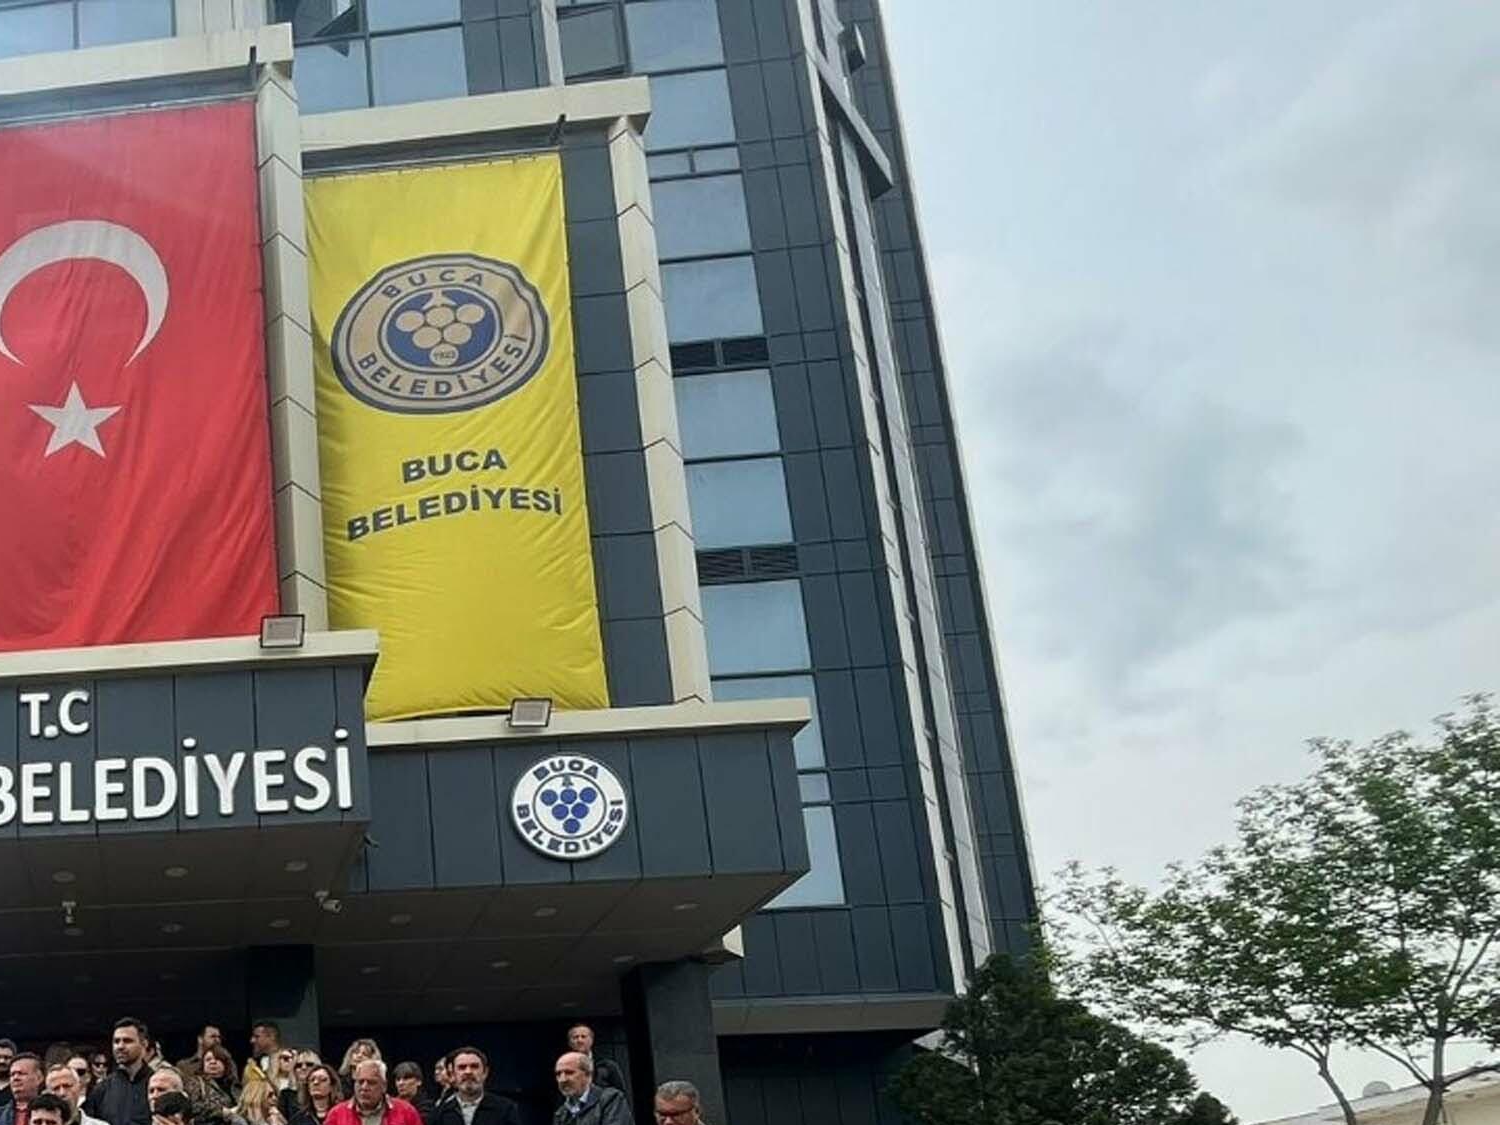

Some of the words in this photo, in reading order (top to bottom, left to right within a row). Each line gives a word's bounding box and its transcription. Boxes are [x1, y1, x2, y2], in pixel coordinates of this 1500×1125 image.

[382, 270, 484, 299] BUCA
[401, 449, 507, 484] BUCA
[347, 484, 562, 542] BELEDİYESİ
[20, 690, 90, 738] T.C
[533, 759, 599, 780] BUCA
